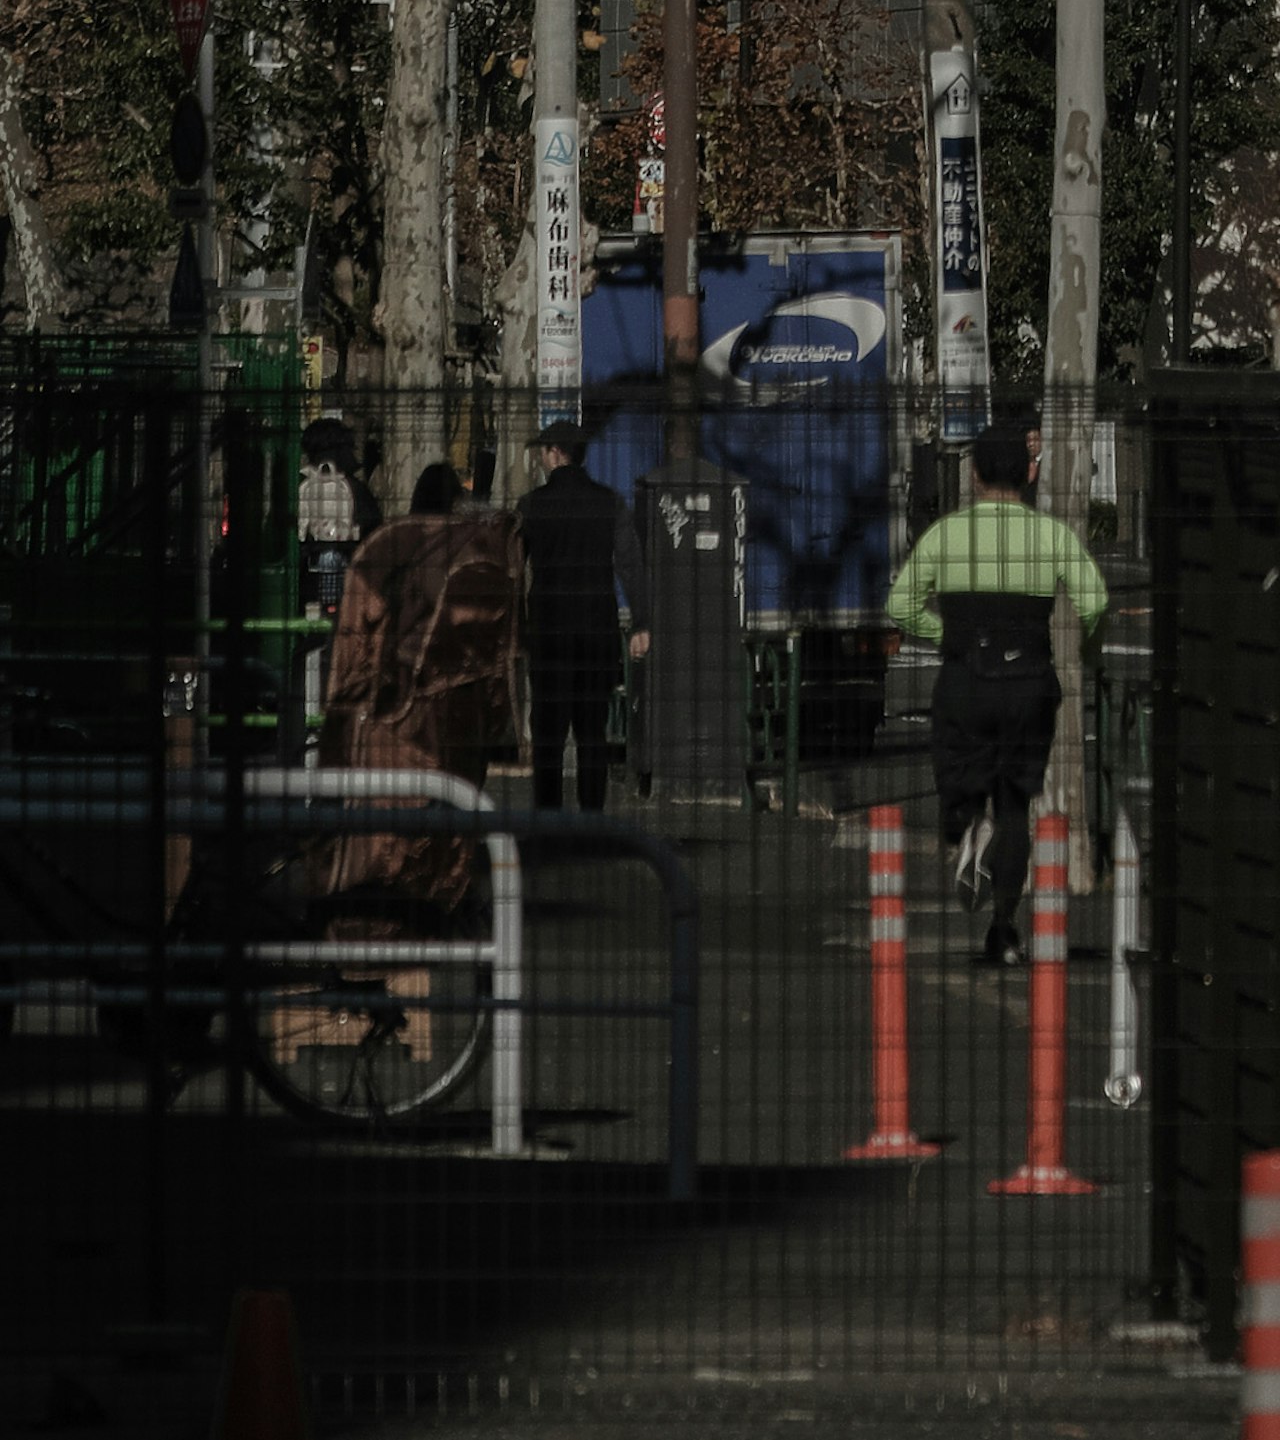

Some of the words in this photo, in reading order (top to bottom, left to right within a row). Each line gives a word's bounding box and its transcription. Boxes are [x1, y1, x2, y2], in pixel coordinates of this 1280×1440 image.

[547, 187, 570, 302] 麻布歯科
[942, 158, 965, 272] 不動産仲介
